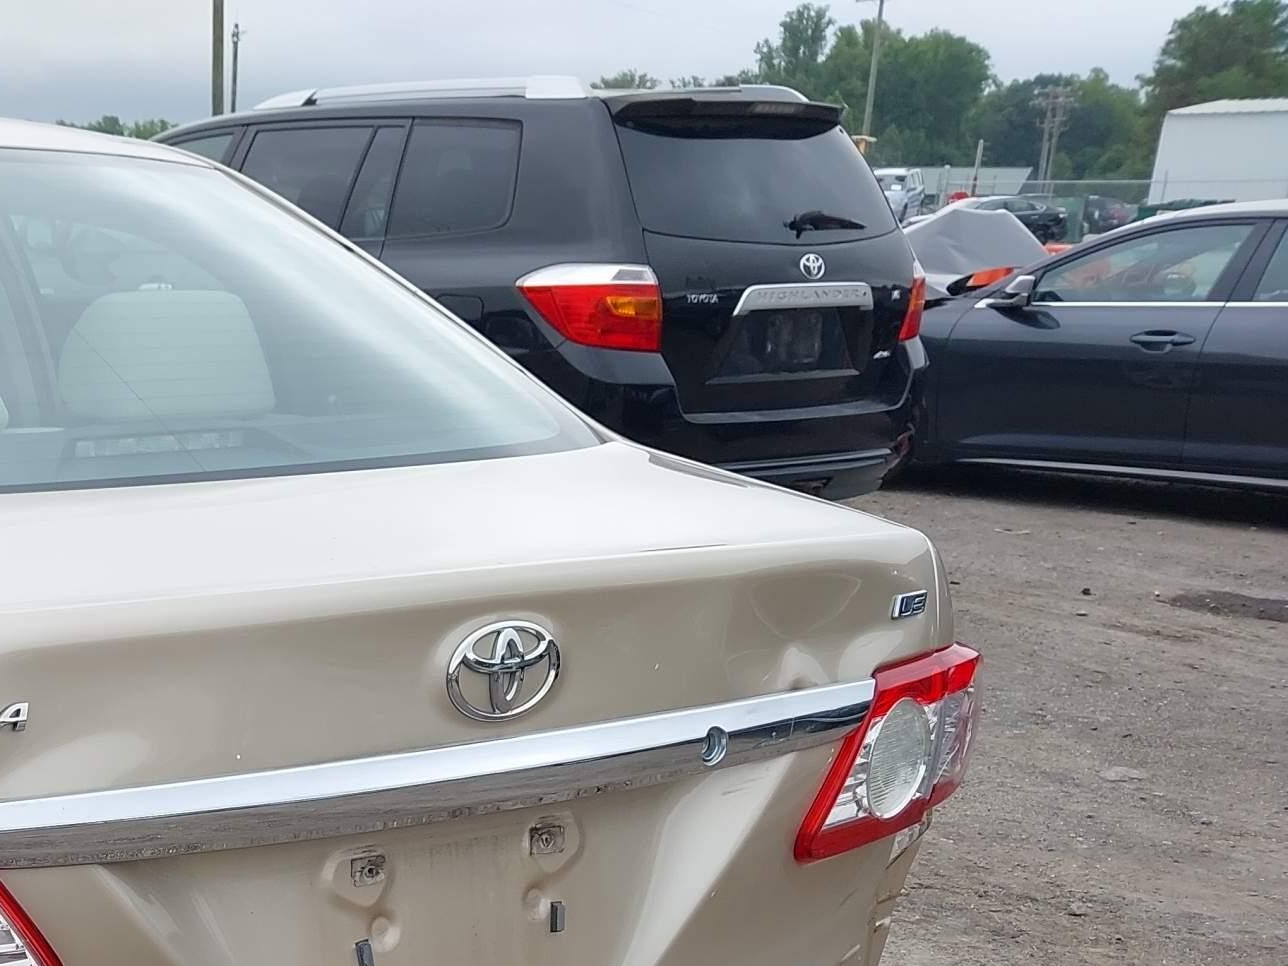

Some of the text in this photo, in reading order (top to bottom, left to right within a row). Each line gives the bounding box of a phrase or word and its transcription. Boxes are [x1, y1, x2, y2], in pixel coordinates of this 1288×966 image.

[687, 293, 719, 304] TOYOTA
[758, 287, 860, 301] HIGHLANDER
[898, 594, 927, 617] LE
